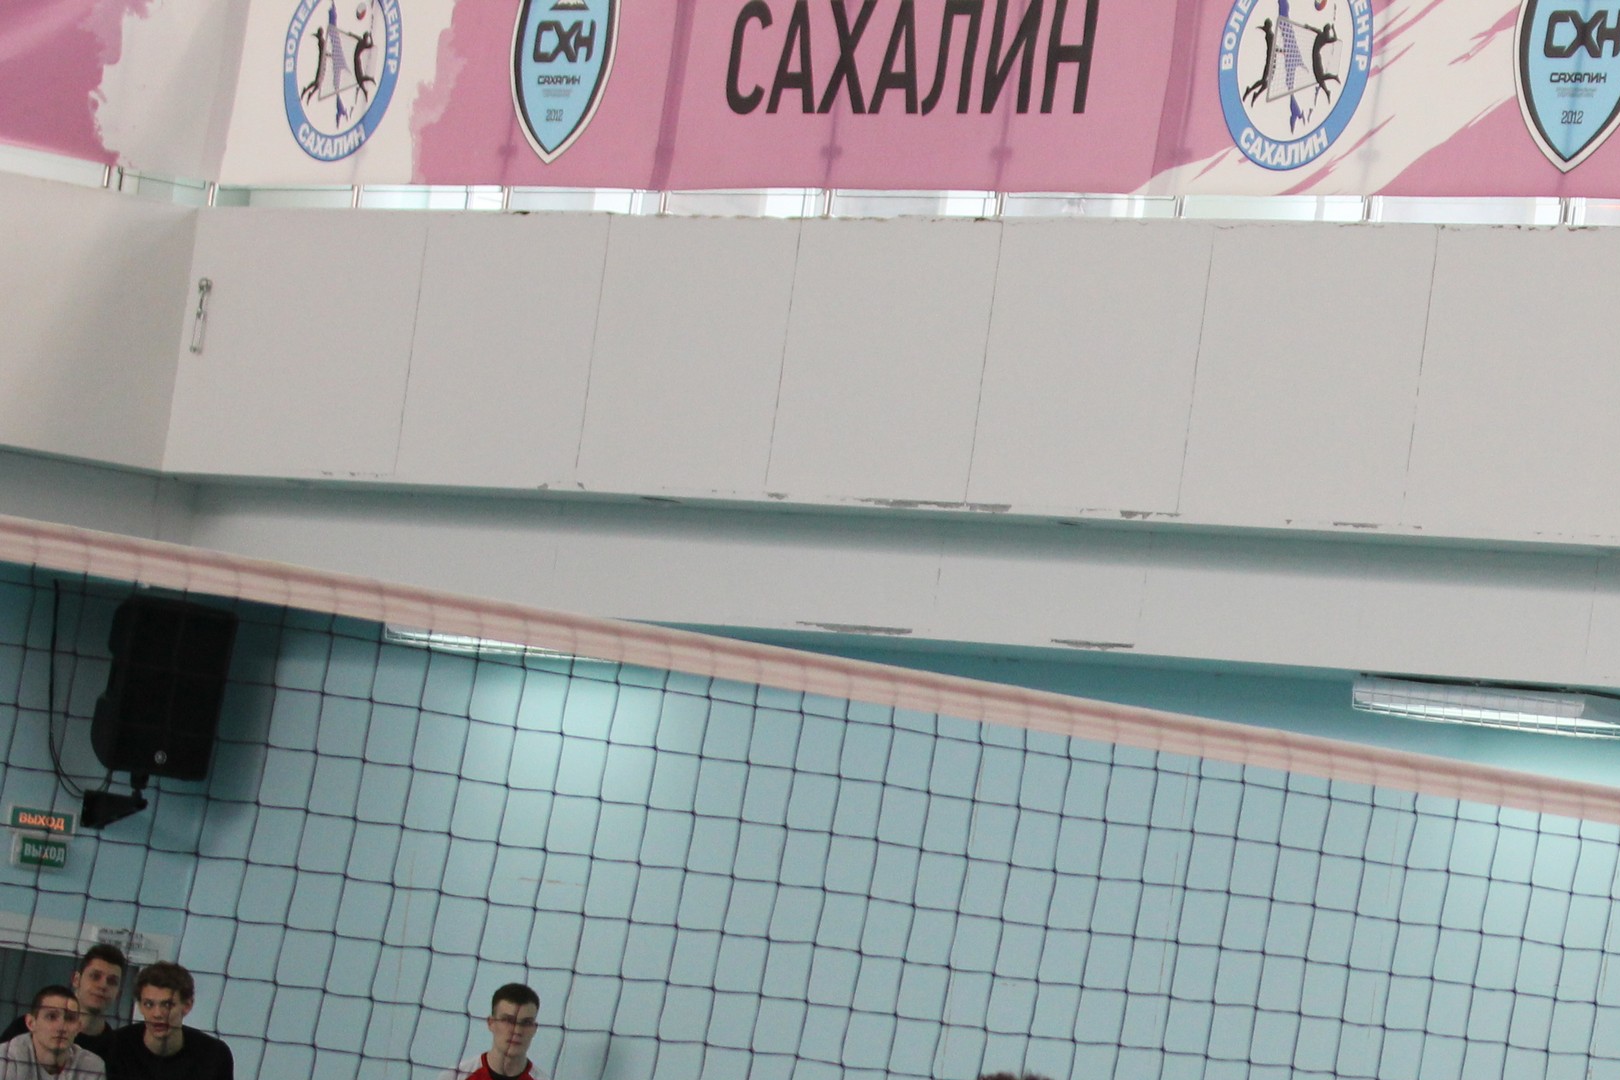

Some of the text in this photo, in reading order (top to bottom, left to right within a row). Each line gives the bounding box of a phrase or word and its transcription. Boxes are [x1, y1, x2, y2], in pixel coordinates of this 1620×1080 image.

[726, 0, 1100, 116] САХАЛИН
[537, 75, 581, 86] САХАЛИН
[1549, 71, 1608, 84] САХАЛИН
[545, 109, 564, 122] 2012
[1560, 110, 1585, 125] 2012
[298, 123, 367, 158] САХАЛИН
[1239, 126, 1329, 167] САХАЛИН
[18, 811, 66, 832] ВЫХОД
[23, 842, 66, 863] ВЫХОД
